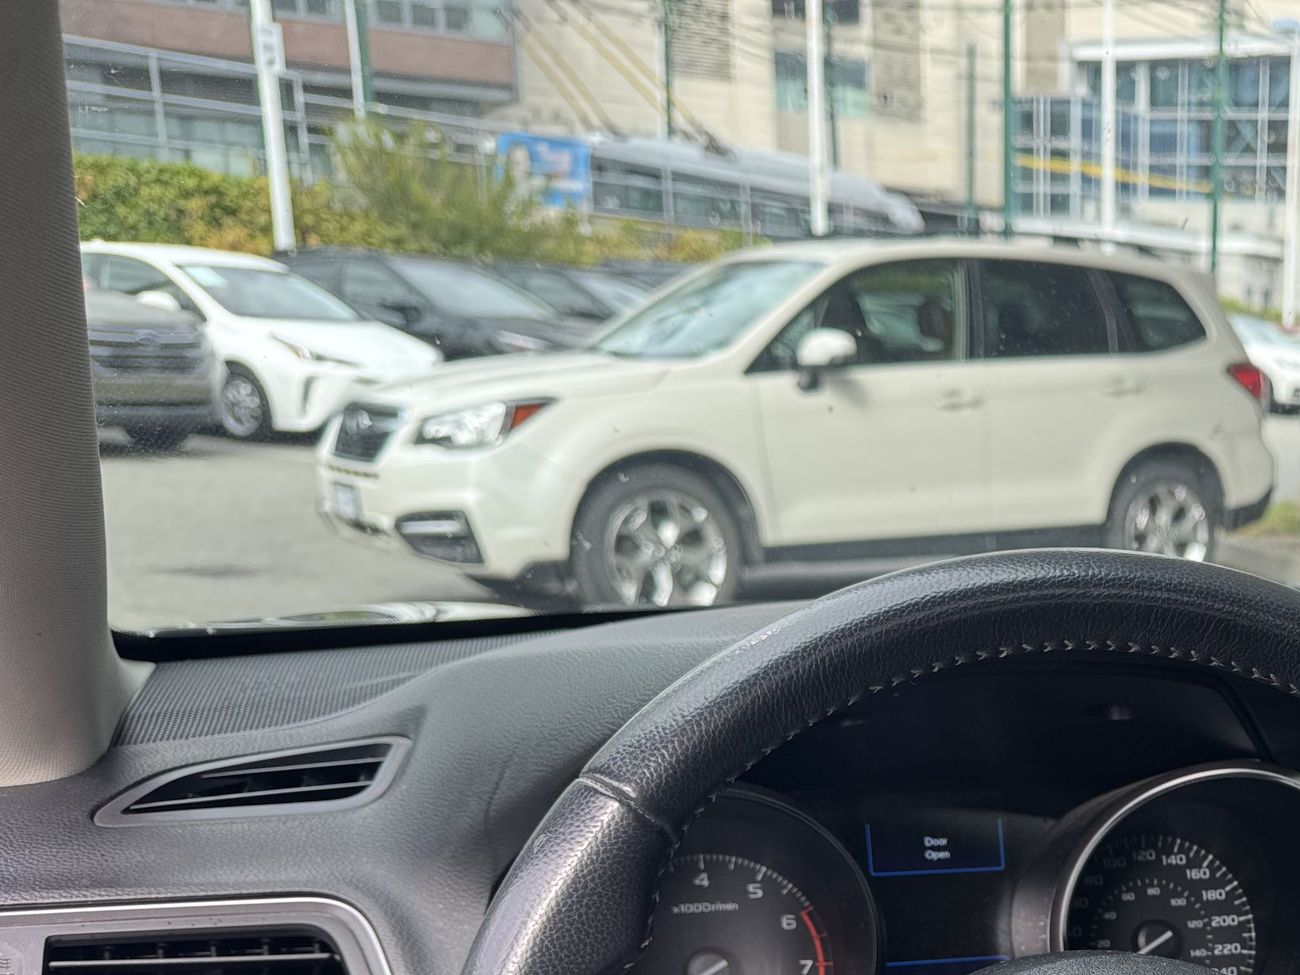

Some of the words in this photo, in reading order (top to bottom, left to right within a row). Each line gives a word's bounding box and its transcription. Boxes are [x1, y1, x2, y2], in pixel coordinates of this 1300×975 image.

[923, 836, 948, 847] Door
[924, 849, 951, 861] Open
[1132, 849, 1156, 861] 120
[1161, 854, 1187, 866] 140
[1186, 868, 1210, 880] 160
[692, 871, 711, 890] 4
[746, 883, 765, 900] 5
[1202, 889, 1226, 901] 180
[780, 914, 798, 931] 6
[1210, 915, 1239, 927] 200
[1213, 942, 1242, 955] 220
[799, 959, 815, 975] 7
